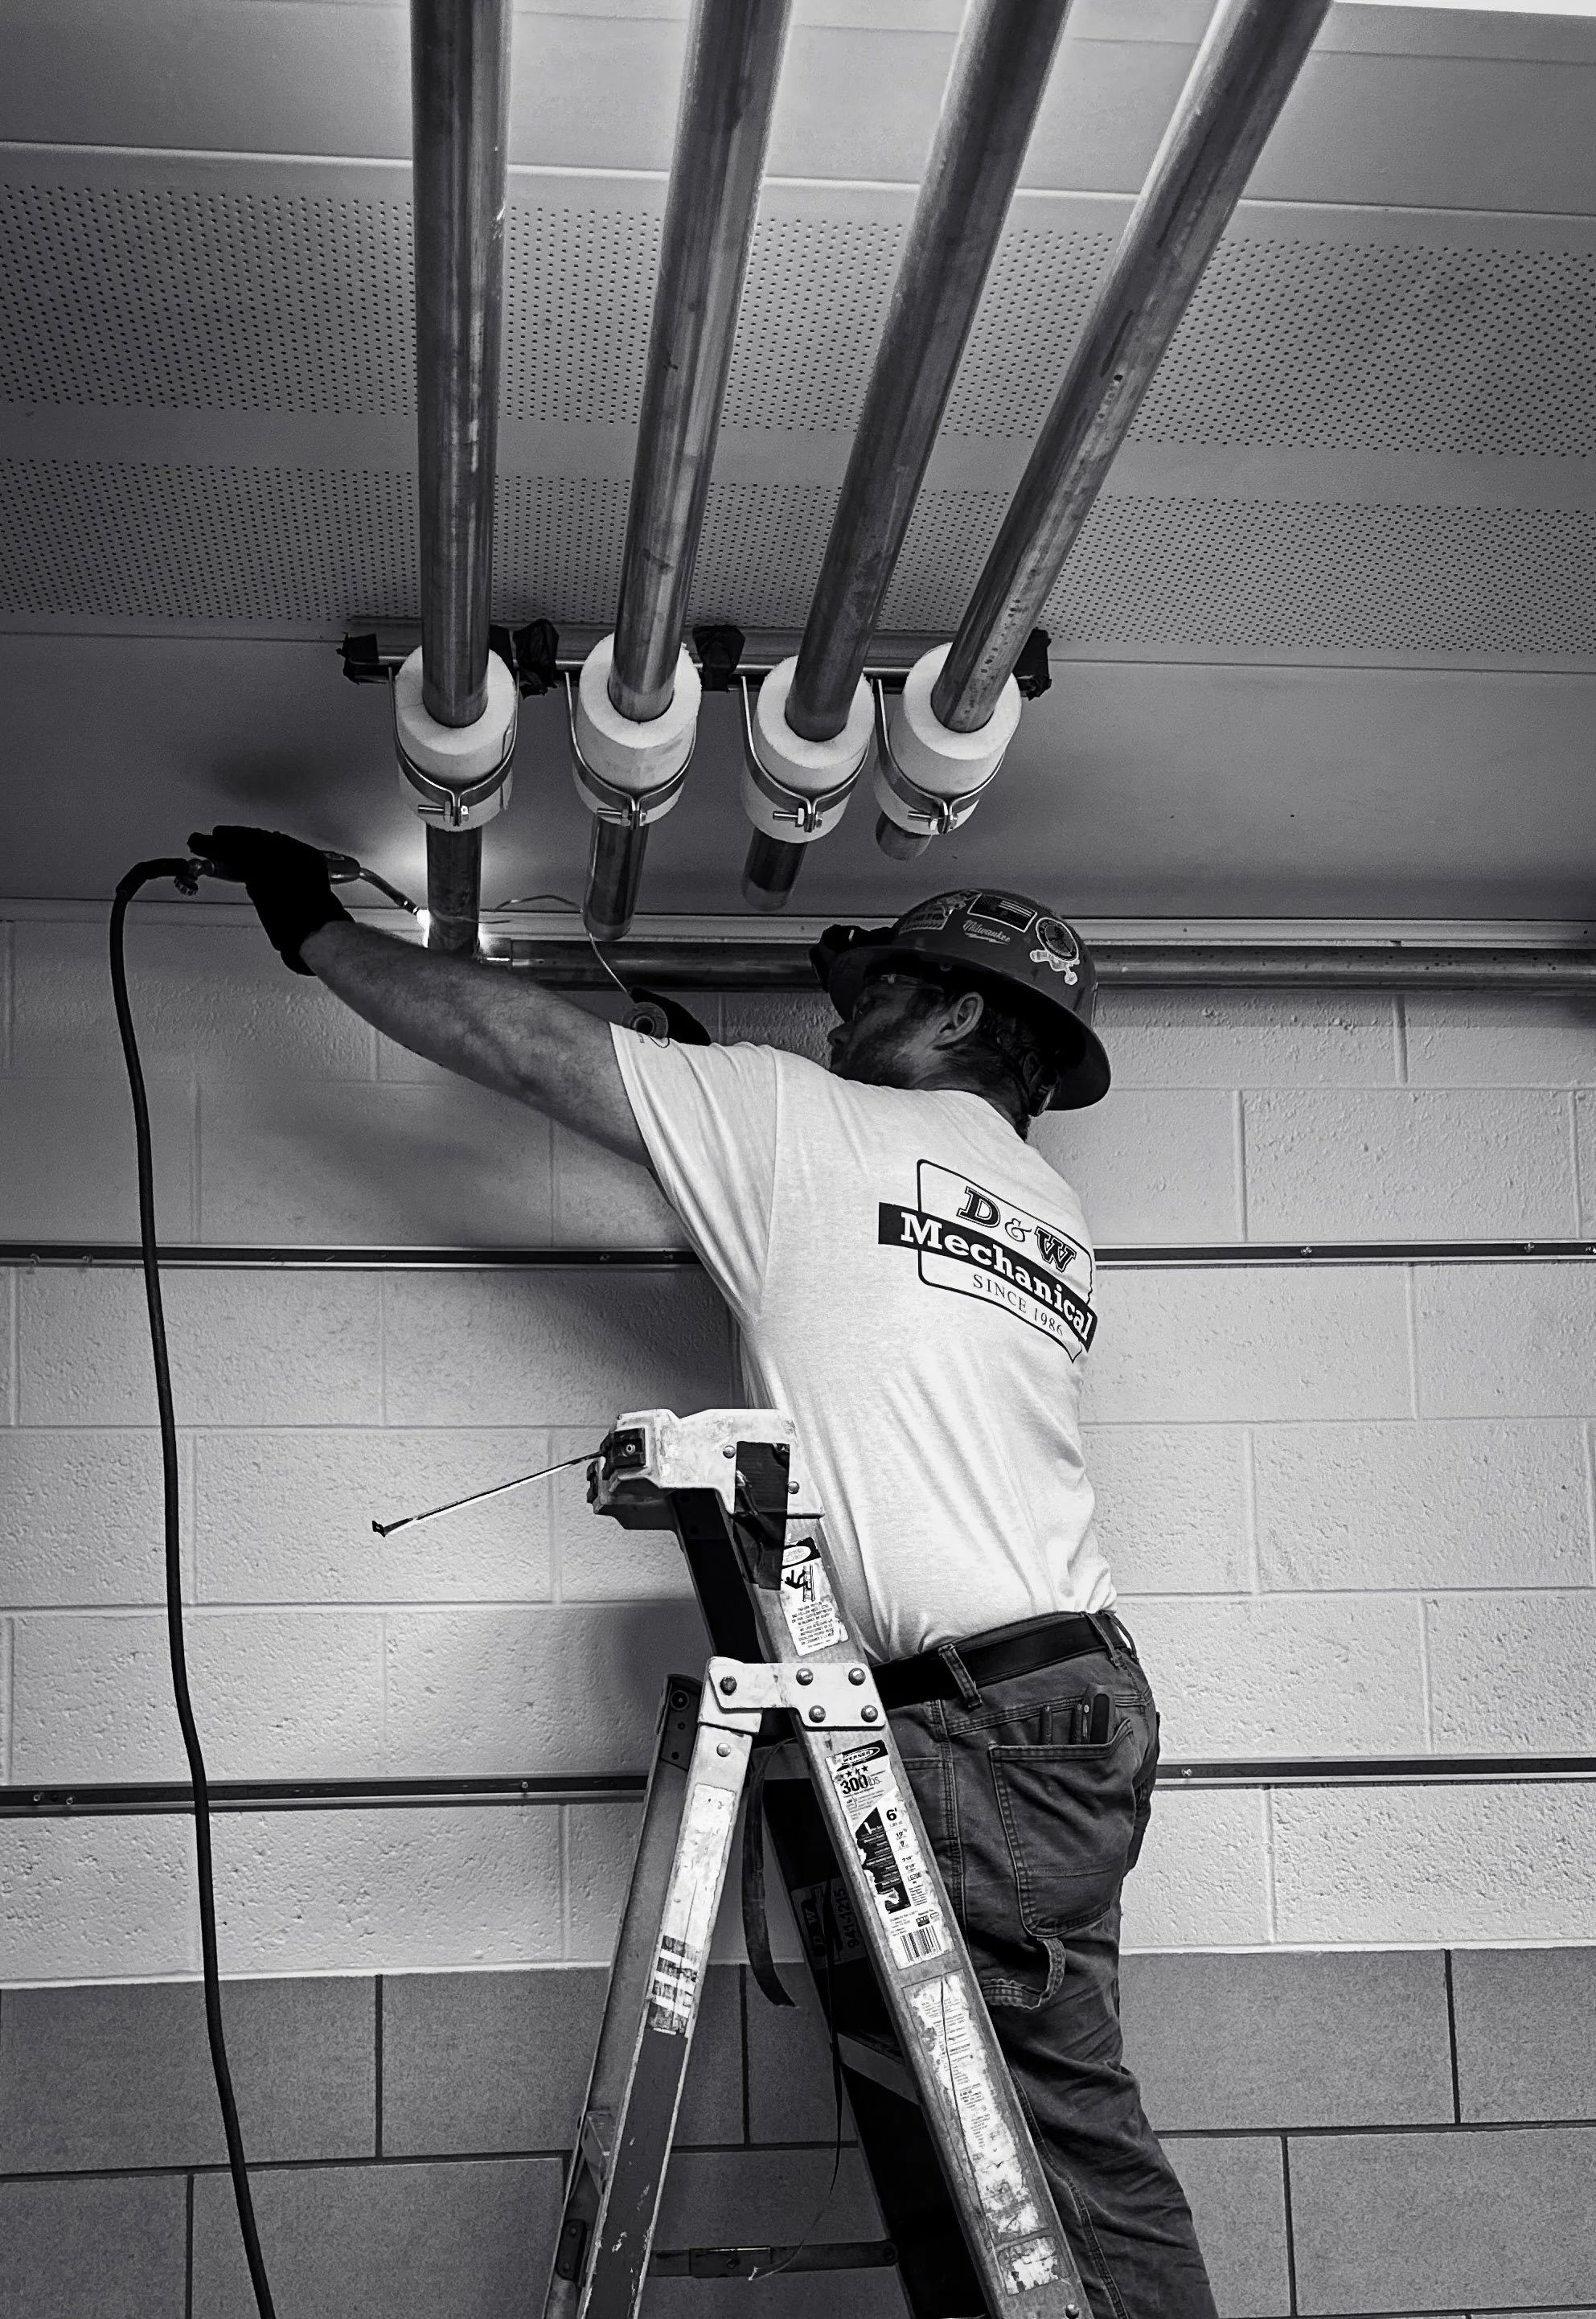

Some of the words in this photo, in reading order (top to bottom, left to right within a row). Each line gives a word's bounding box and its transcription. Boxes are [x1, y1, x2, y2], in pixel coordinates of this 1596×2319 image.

[962, 919, 1011, 942] Milwaukee
[901, 1212, 1093, 1340] Mechanical
[972, 1274, 1028, 1313] SINCE
[1033, 1307, 1064, 1336] 1986
[886, 1807, 897, 1821] 6'
